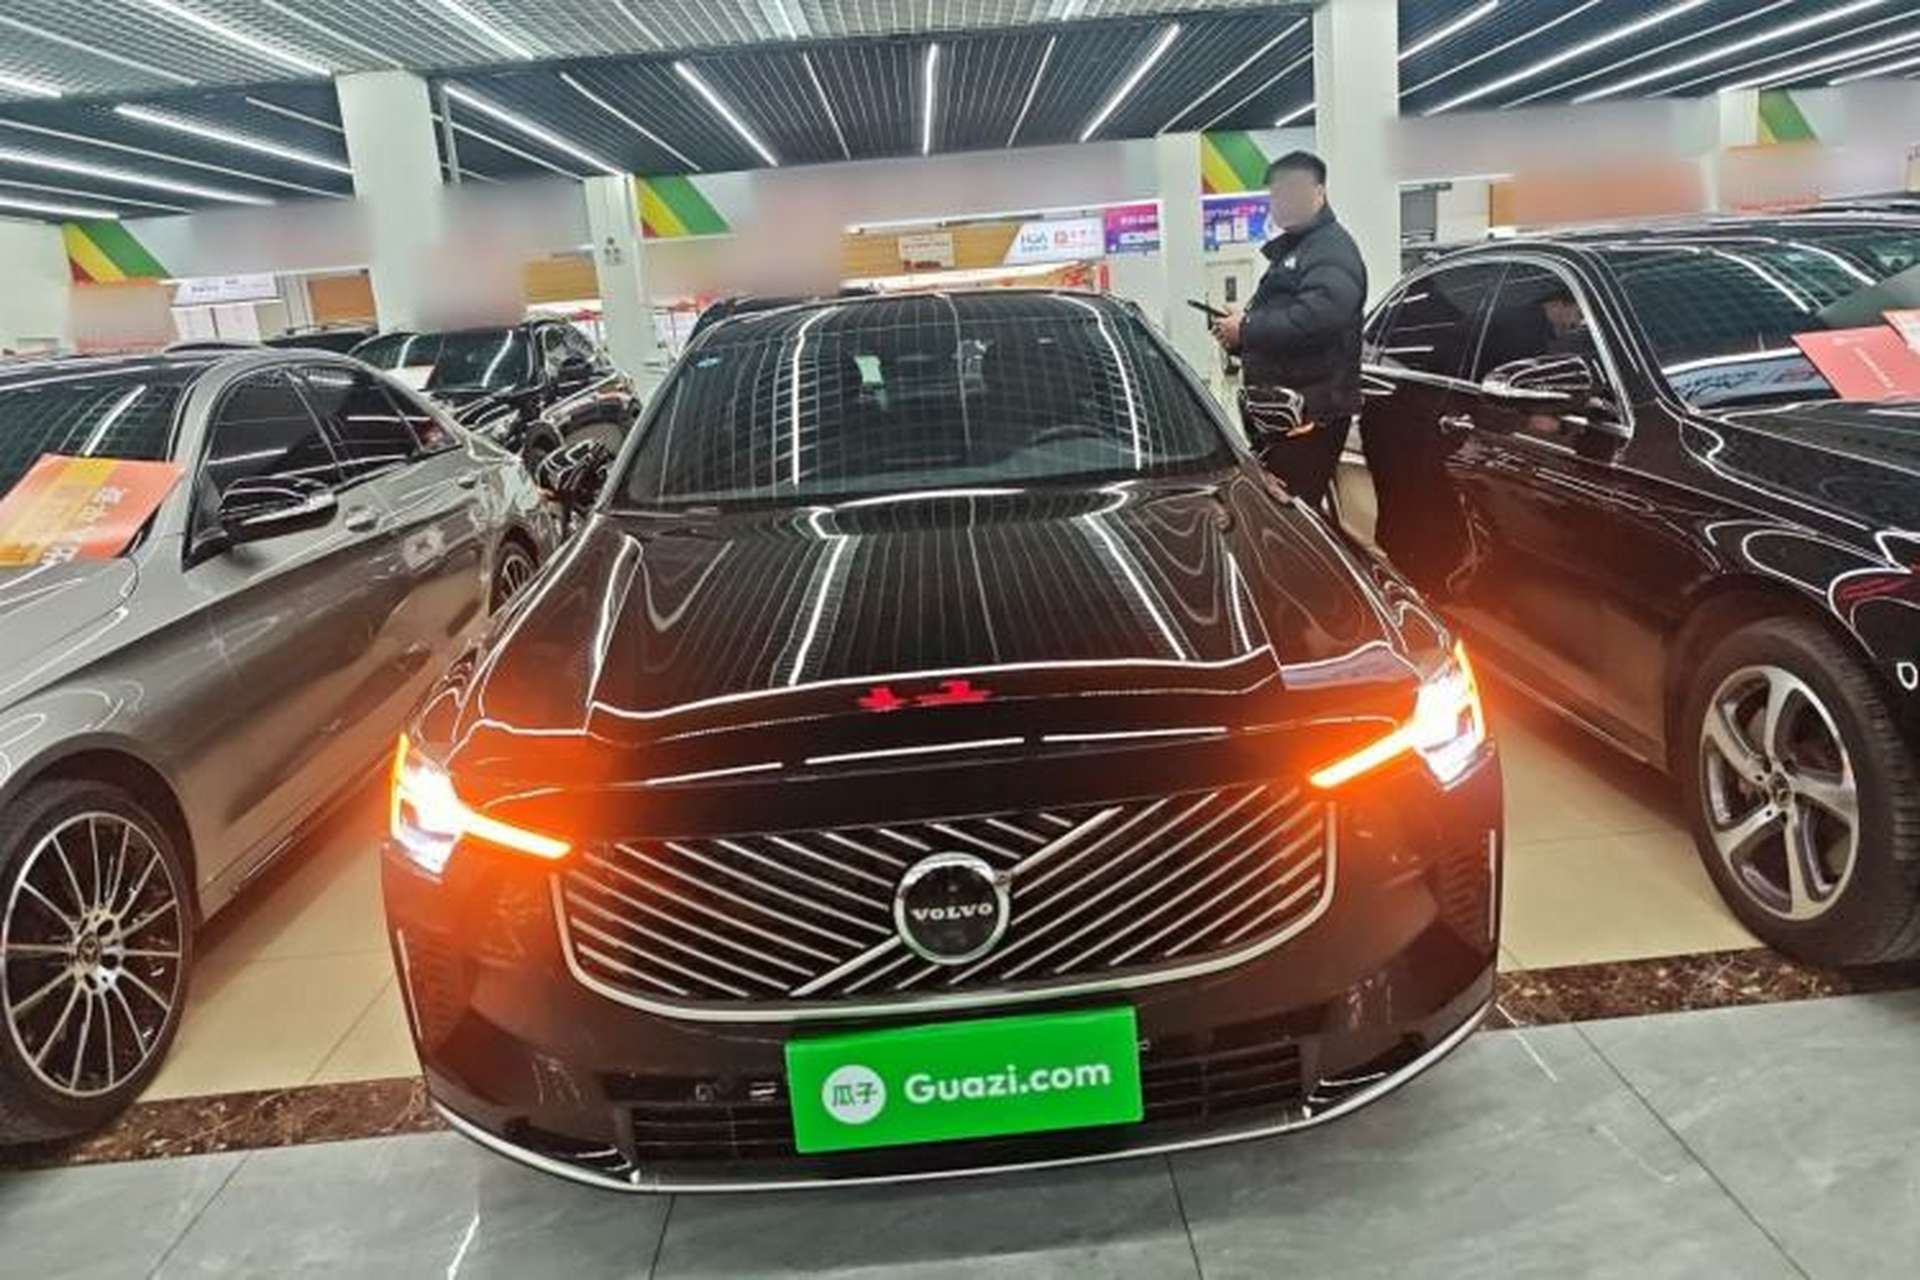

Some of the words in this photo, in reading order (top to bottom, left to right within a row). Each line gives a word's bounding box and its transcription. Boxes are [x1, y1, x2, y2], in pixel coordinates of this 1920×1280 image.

[911, 902, 993, 920] VOLVO
[832, 1082, 878, 1107] 瓜子
[904, 1063, 1111, 1104] Guazi.com
